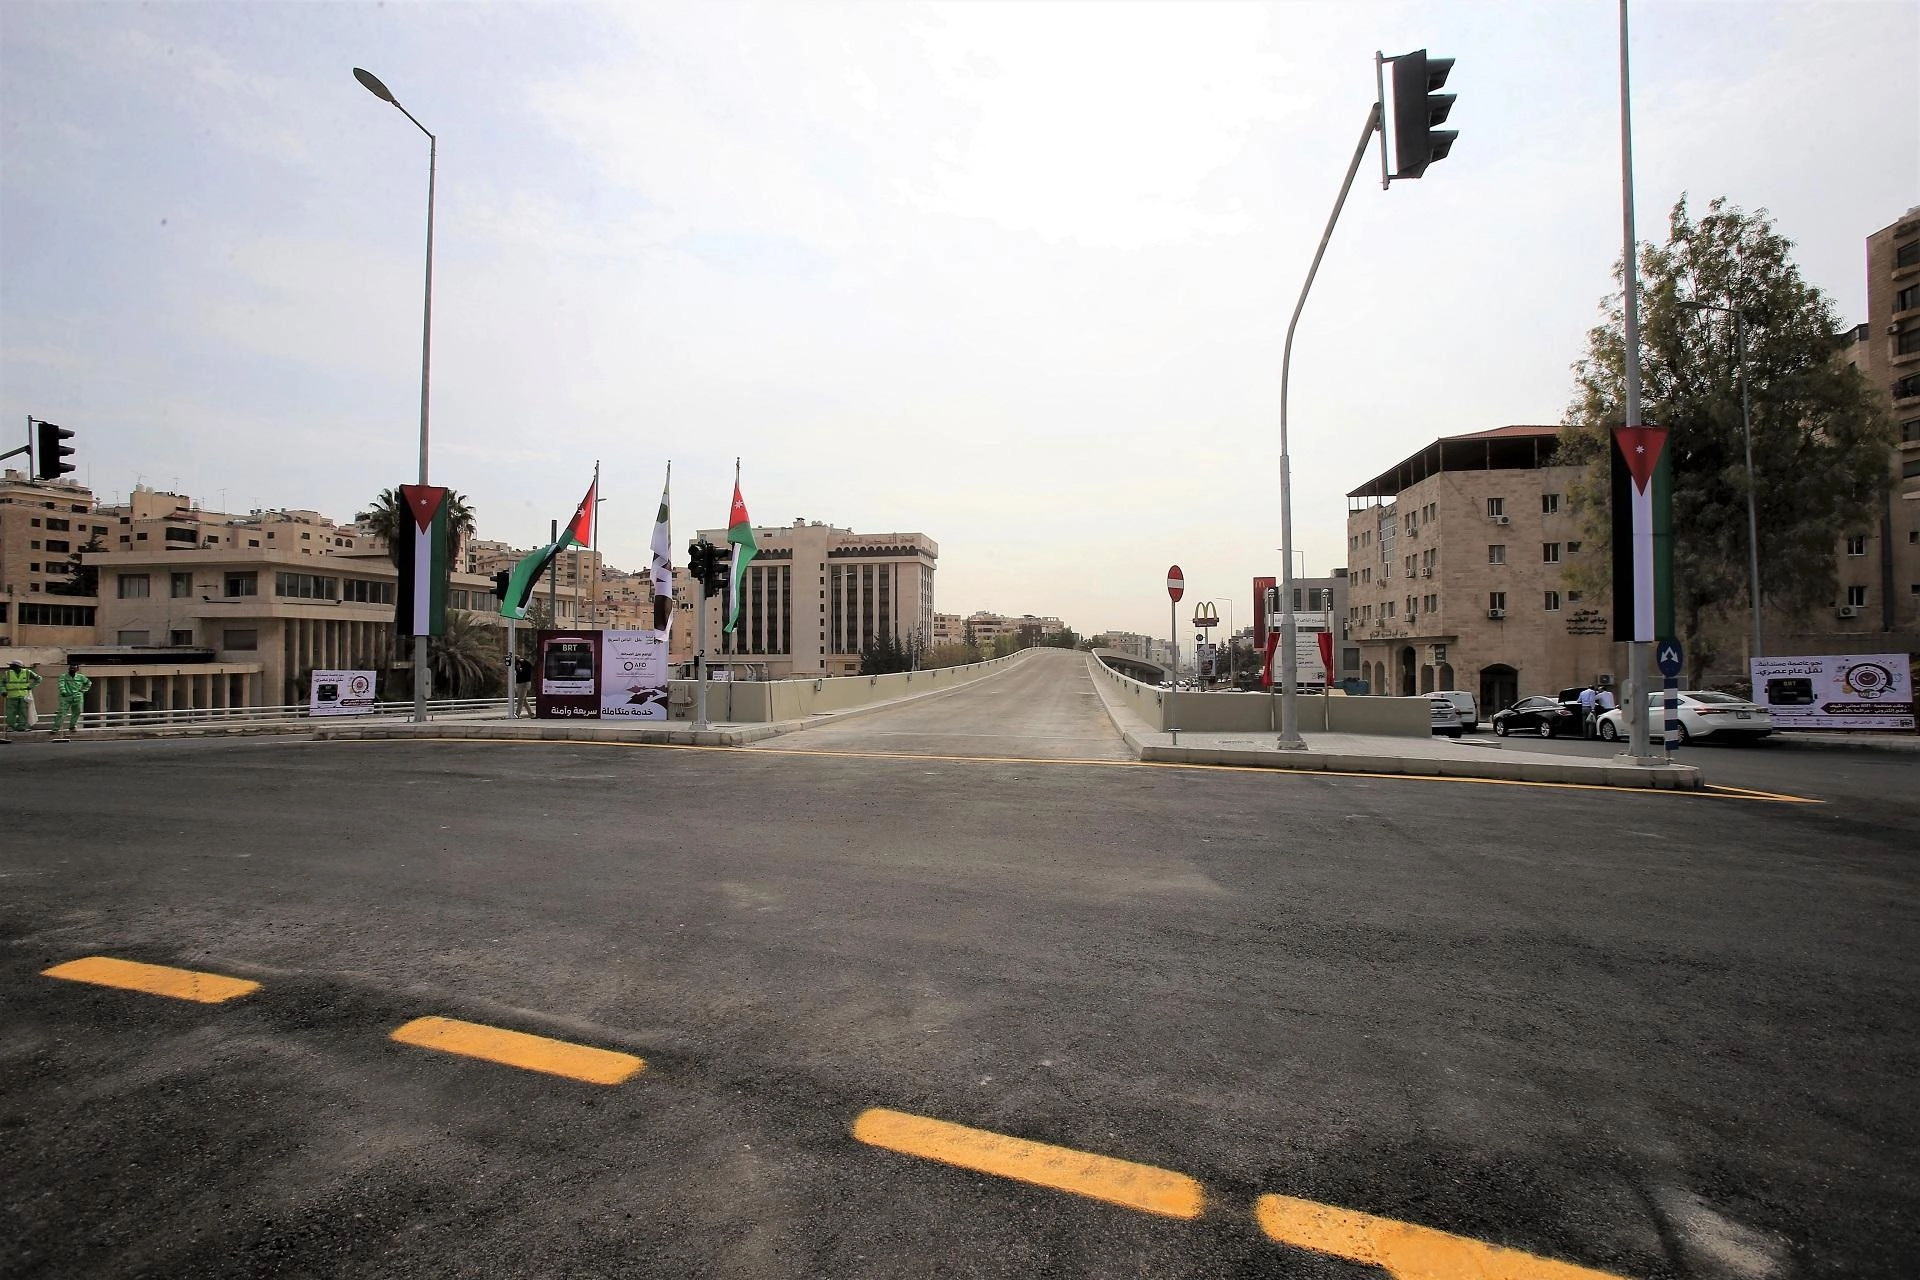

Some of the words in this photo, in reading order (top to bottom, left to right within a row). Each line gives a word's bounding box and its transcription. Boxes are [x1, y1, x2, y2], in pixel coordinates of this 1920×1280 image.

[562, 644, 578, 652] BRT
[572, 706, 598, 717] سريعة
[602, 707, 630, 716] متكاملة
[631, 707, 653, 716] خدمة
